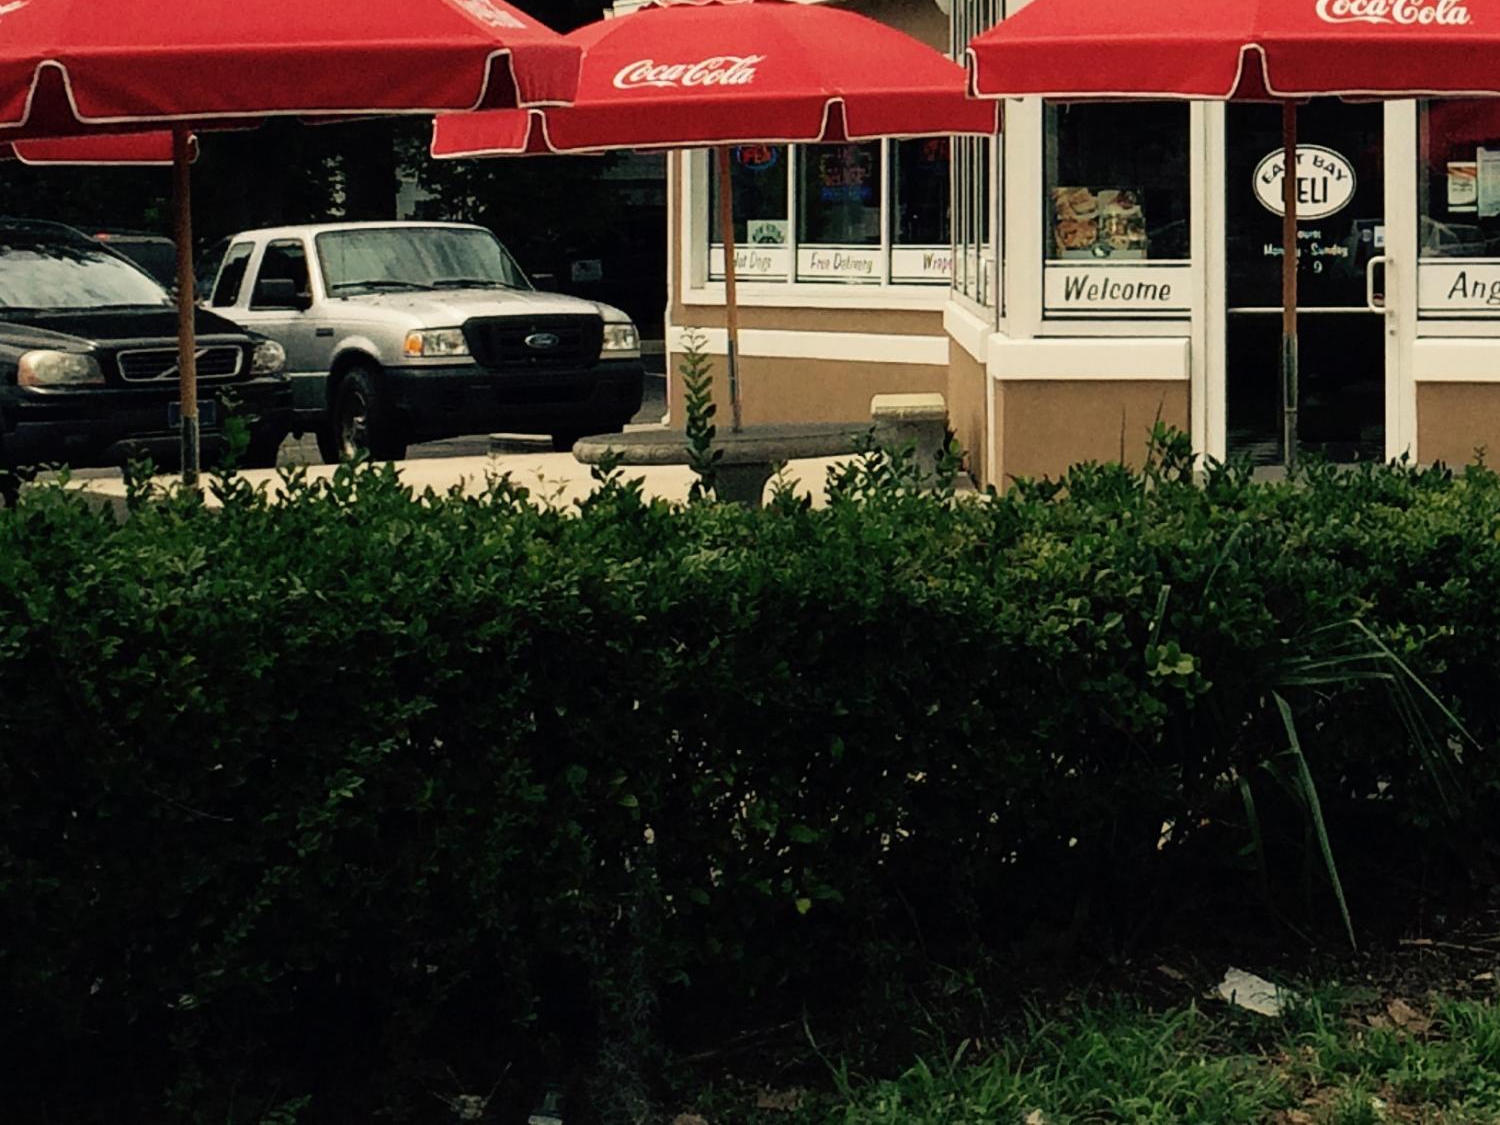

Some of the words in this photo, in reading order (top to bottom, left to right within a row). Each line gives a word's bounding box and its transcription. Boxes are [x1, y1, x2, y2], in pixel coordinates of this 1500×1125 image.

[612, 55, 767, 89] Coca-Cola
[1261, 154, 1304, 184] EAT
[1312, 155, 1348, 181] BAY
[1281, 176, 1327, 204] ELI
[810, 253, 830, 269] Free
[833, 252, 873, 273] Delivery
[1064, 275, 1171, 301] Welcome
